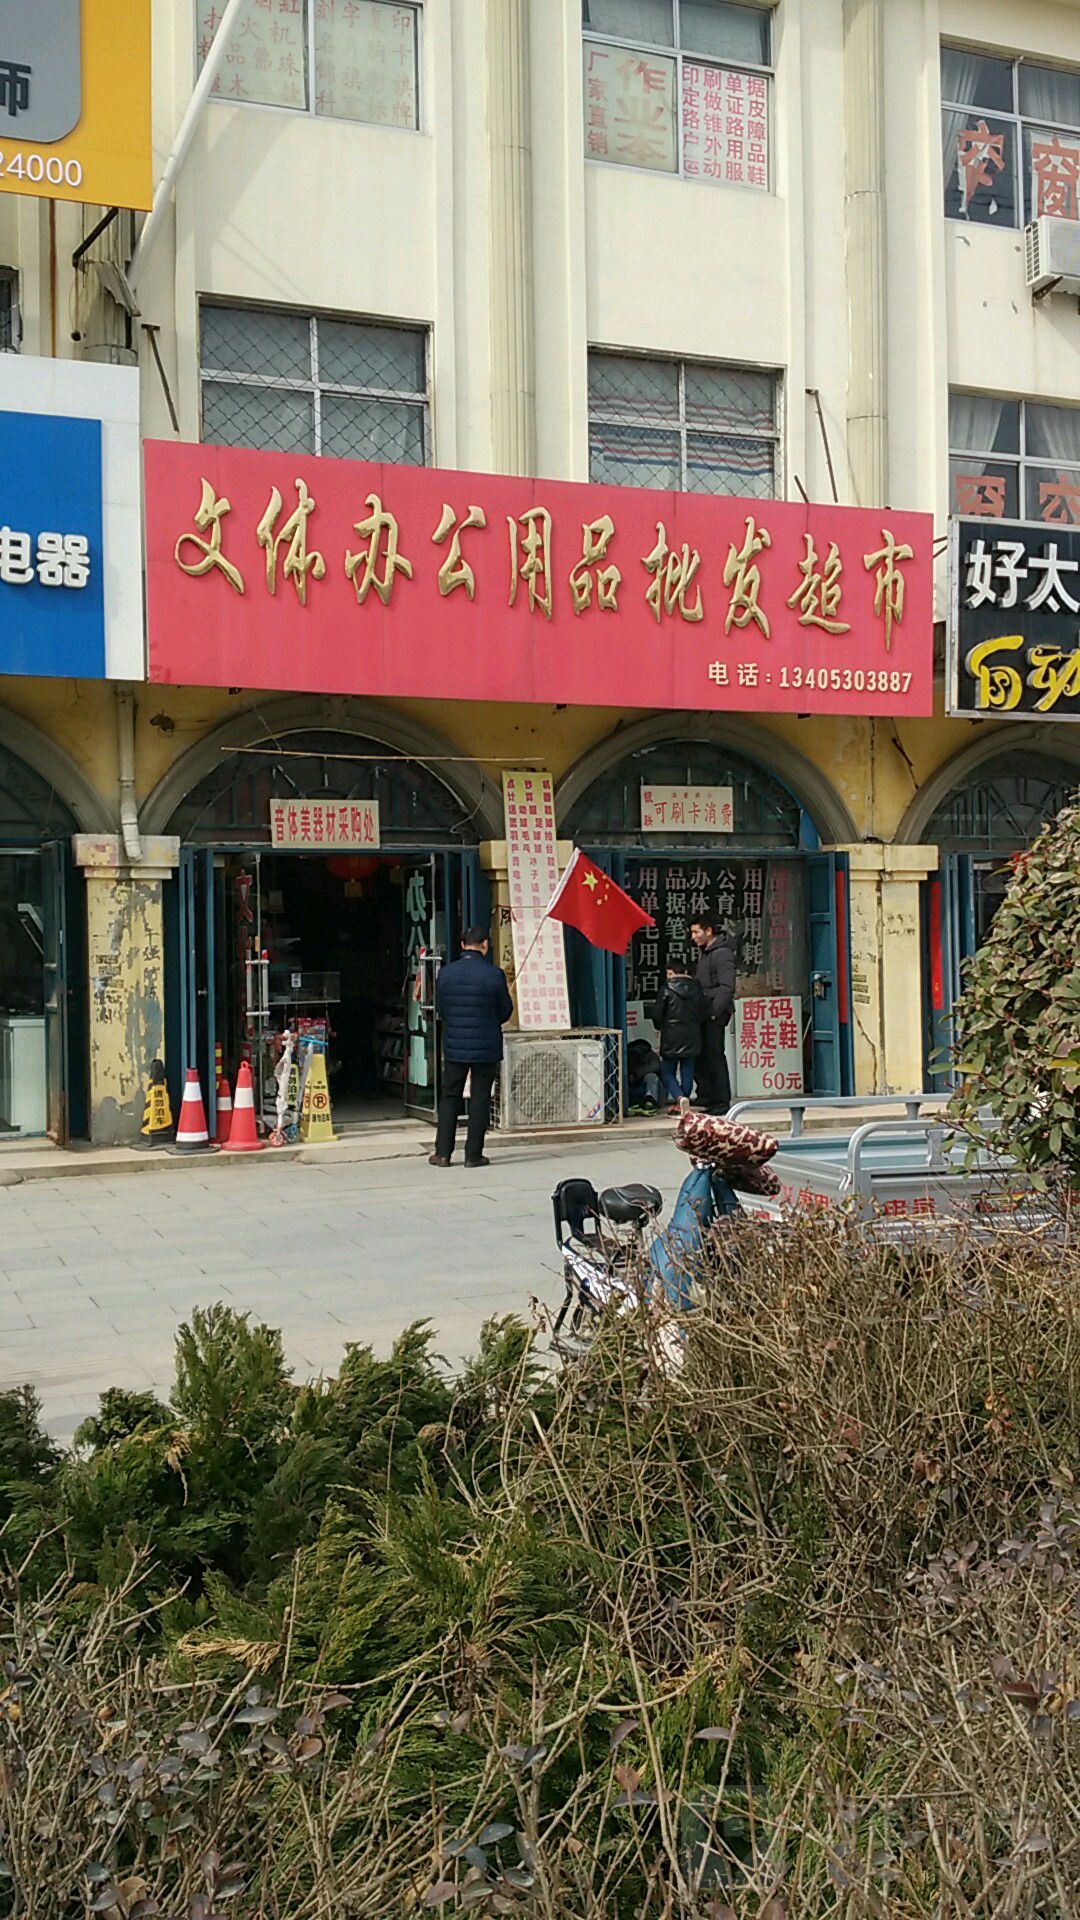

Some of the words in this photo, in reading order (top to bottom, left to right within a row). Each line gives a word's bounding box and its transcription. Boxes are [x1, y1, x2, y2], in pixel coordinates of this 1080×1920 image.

[682, 65, 766, 99] 印刷单据
[682, 87, 766, 121] 定做证皮
[683, 108, 766, 142] 路锥路障
[683, 131, 766, 164] 户外用品
[0, 150, 82, 186] 4000
[683, 153, 766, 186] 运动服鞋
[0, 525, 90, 588] 电器
[175, 477, 915, 652] 文体办公用品批发超市
[964, 540, 1080, 613] 好太
[275, 806, 374, 842] 音体美器材采购处
[654, 801, 732, 826] 可刷卡消费
[743, 998, 793, 1020] 断码
[741, 1021, 797, 1050] 暴走鞋
[739, 1051, 775, 1068] 40元
[762, 1072, 802, 1090] 60元
